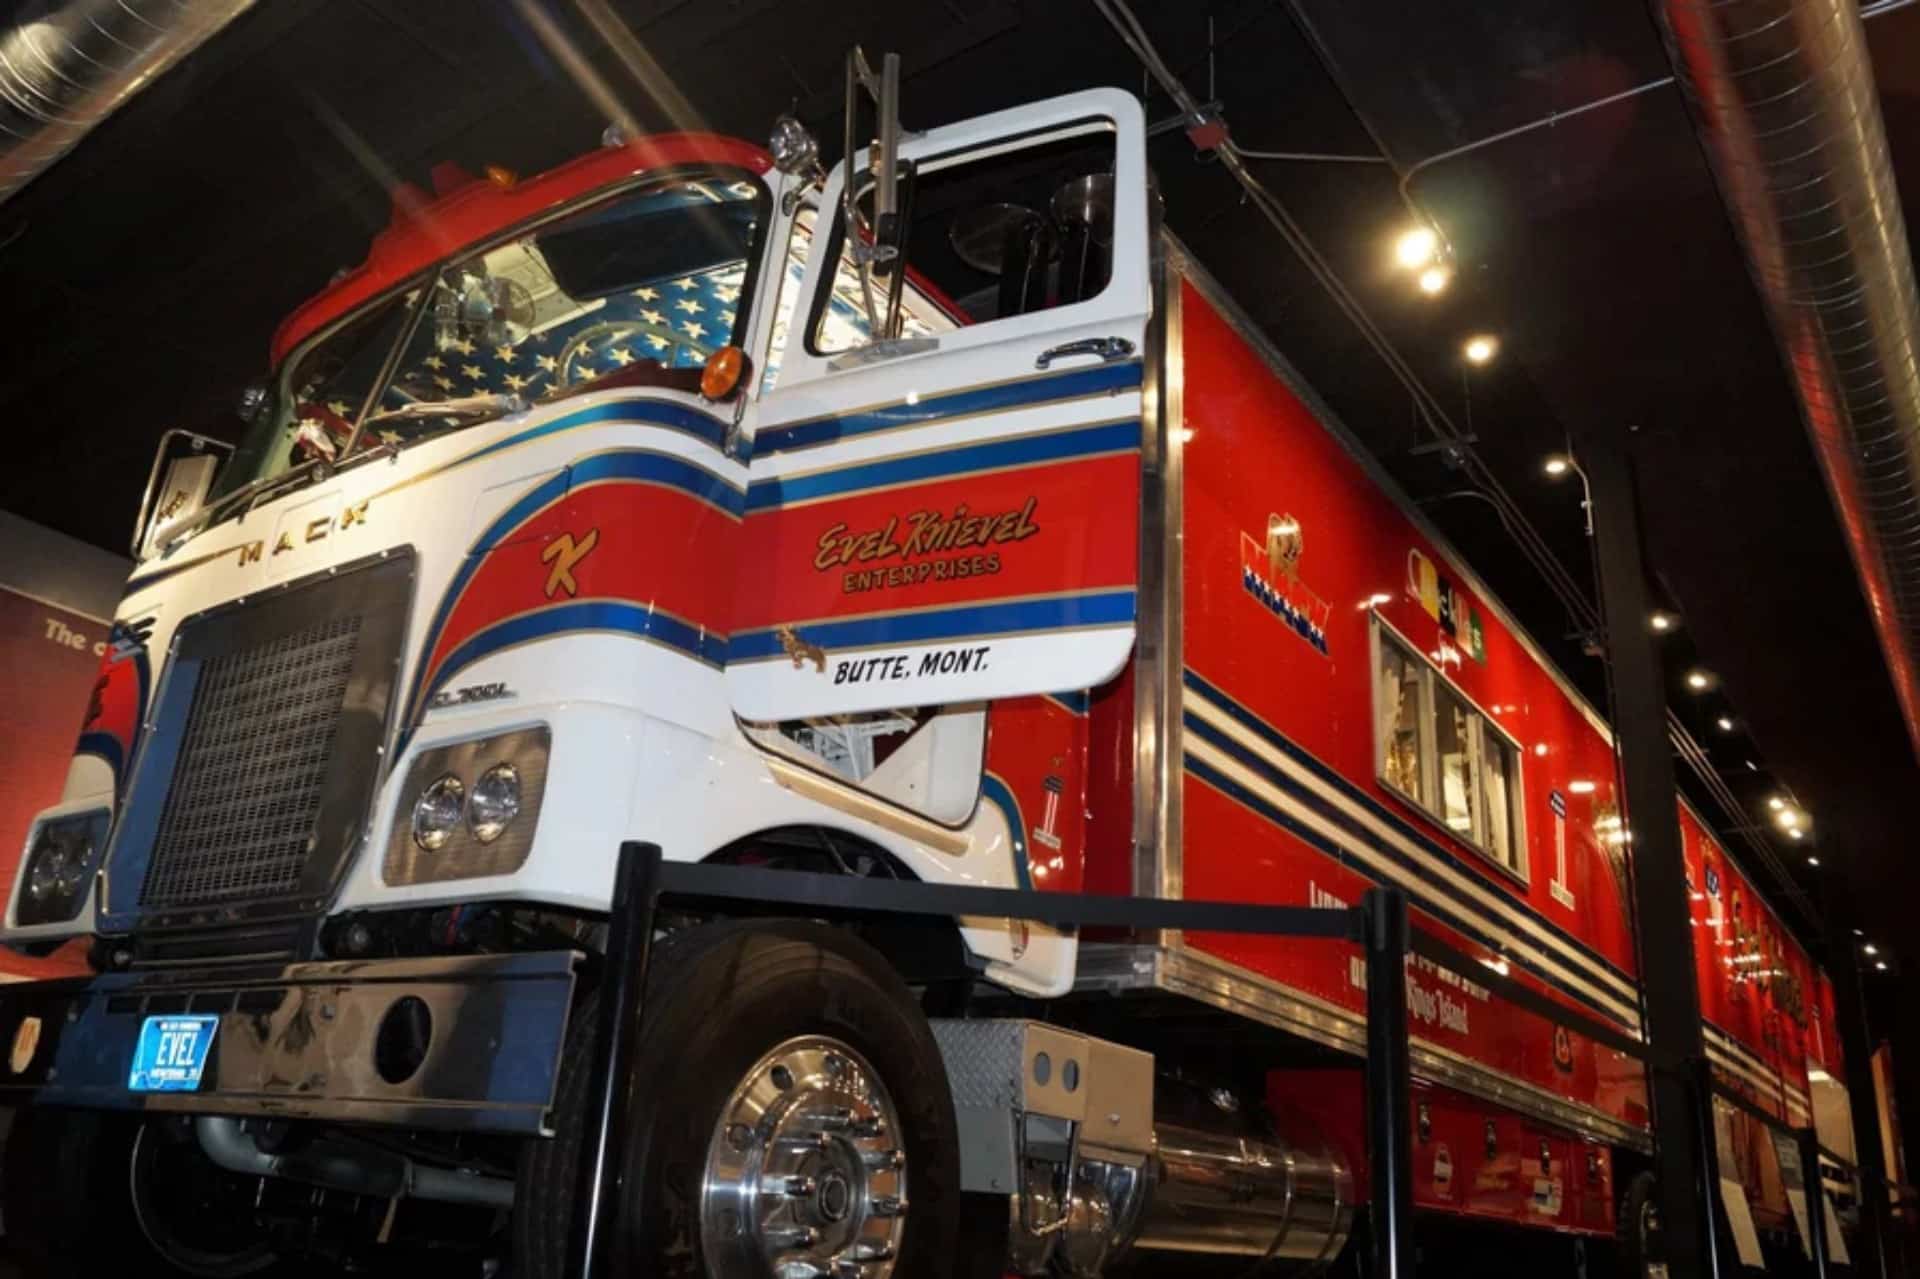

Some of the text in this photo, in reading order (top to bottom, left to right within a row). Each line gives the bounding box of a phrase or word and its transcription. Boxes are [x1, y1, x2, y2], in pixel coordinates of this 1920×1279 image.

[238, 501, 369, 567] MACK
[815, 497, 1040, 570] Evel Knievel
[541, 529, 600, 599] K
[843, 553, 1001, 593] ENTERPRISES
[45, 618, 86, 651] The
[833, 647, 990, 685] BUTTE, MONT.
[156, 1031, 198, 1065] EVEL
